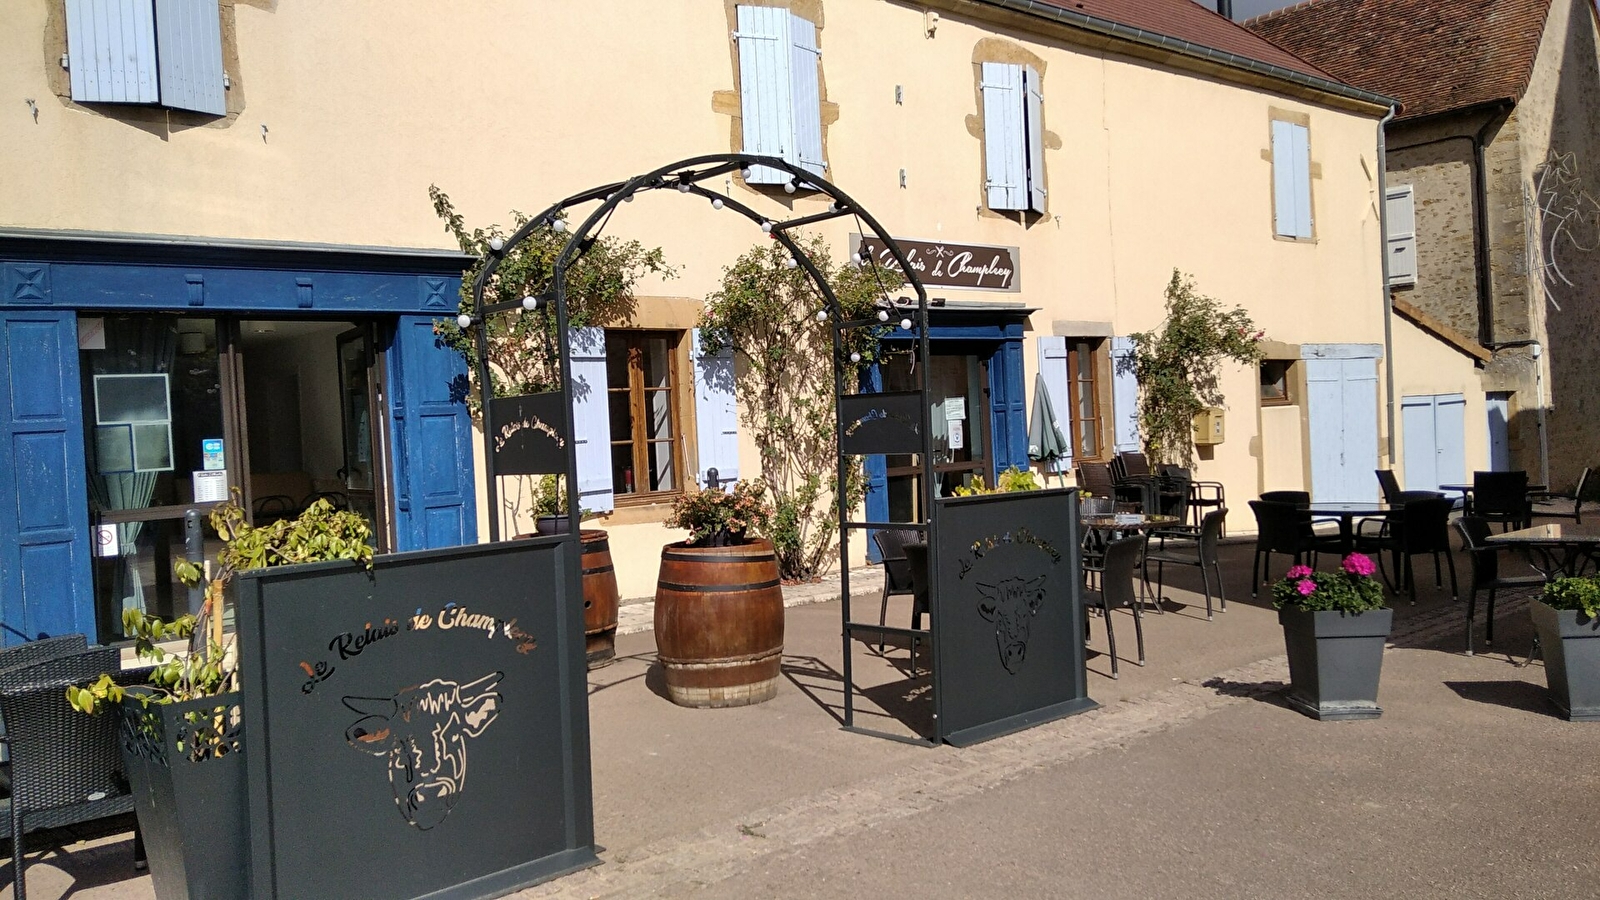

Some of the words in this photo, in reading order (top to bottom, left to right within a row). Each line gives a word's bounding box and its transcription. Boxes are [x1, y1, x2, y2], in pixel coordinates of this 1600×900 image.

[880, 248, 926, 273] Rlais
[931, 260, 943, 277] de
[299, 661, 336, 695] Le
[328, 618, 399, 661] Relais
[406, 607, 432, 631] de
